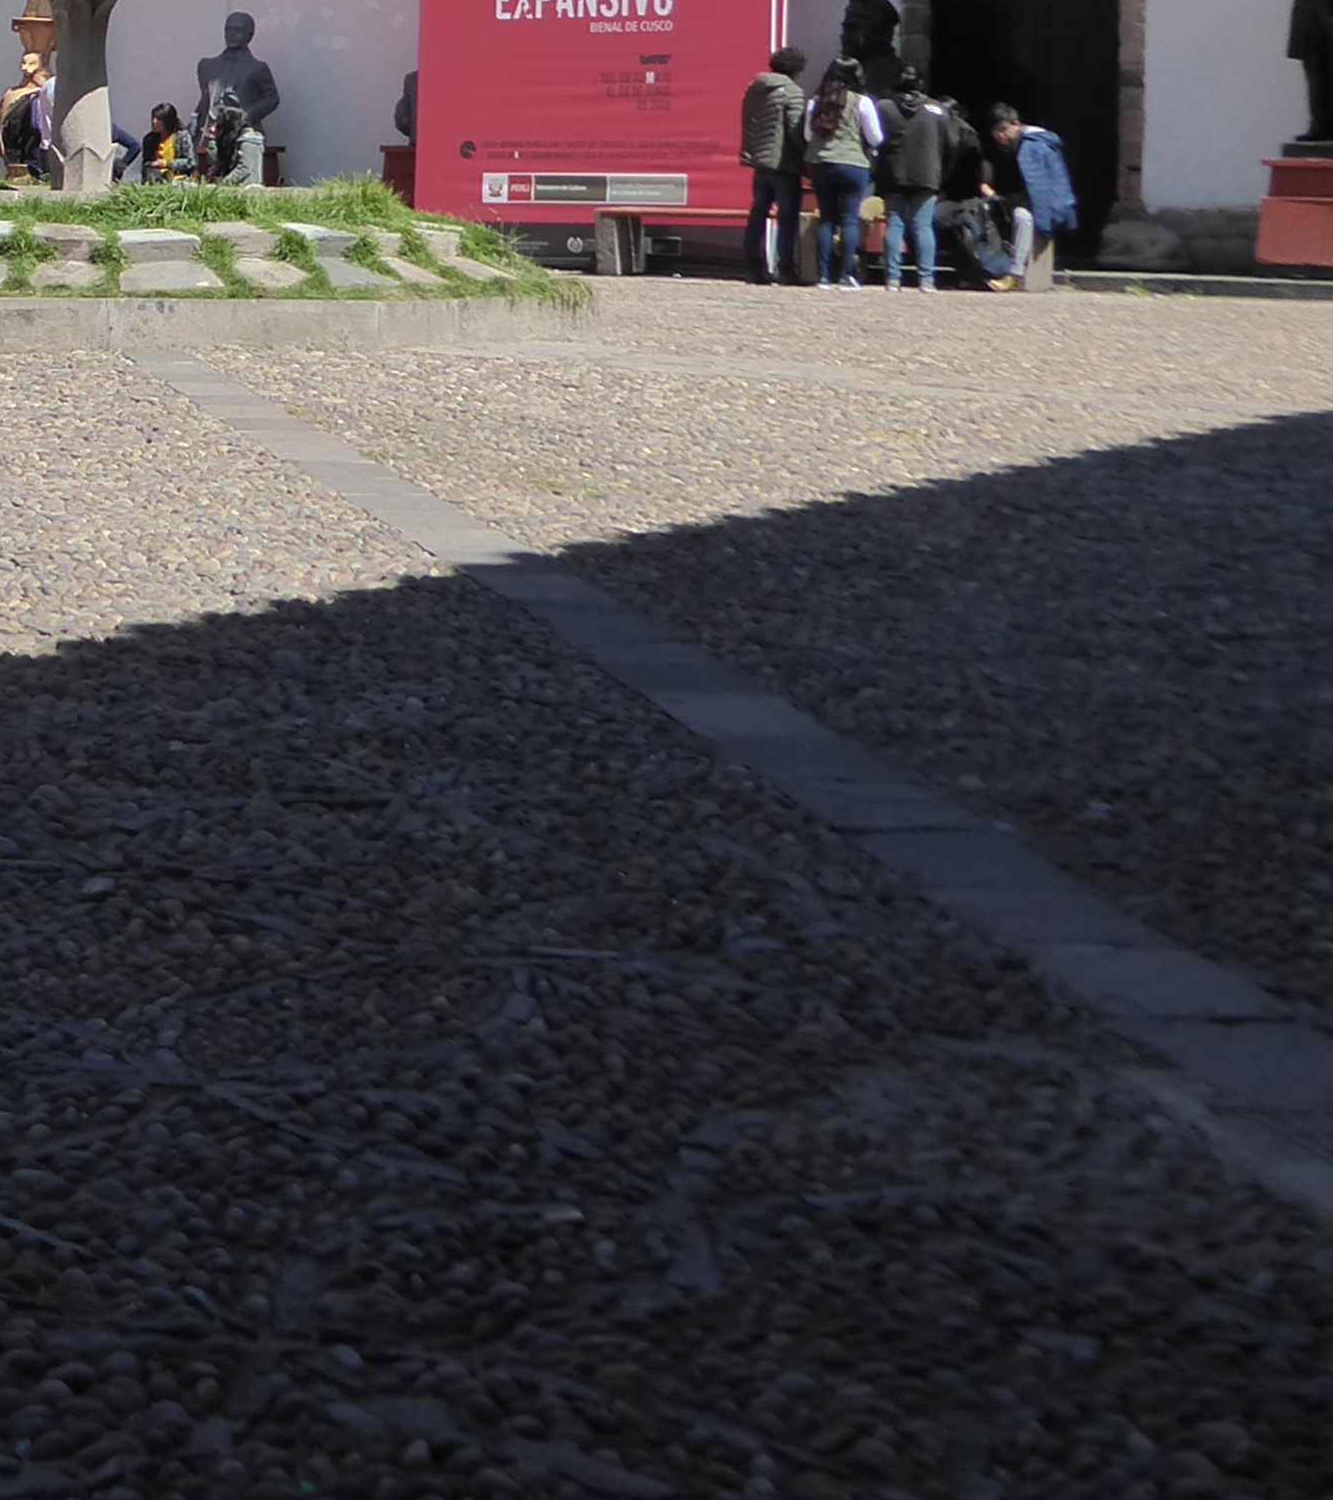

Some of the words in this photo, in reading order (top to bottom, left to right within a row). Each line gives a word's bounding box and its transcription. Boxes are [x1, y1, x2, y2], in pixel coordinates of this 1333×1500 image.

[589, 21, 624, 34] BIENAL
[625, 20, 639, 32] DE
[639, 19, 674, 32] CUSCO
